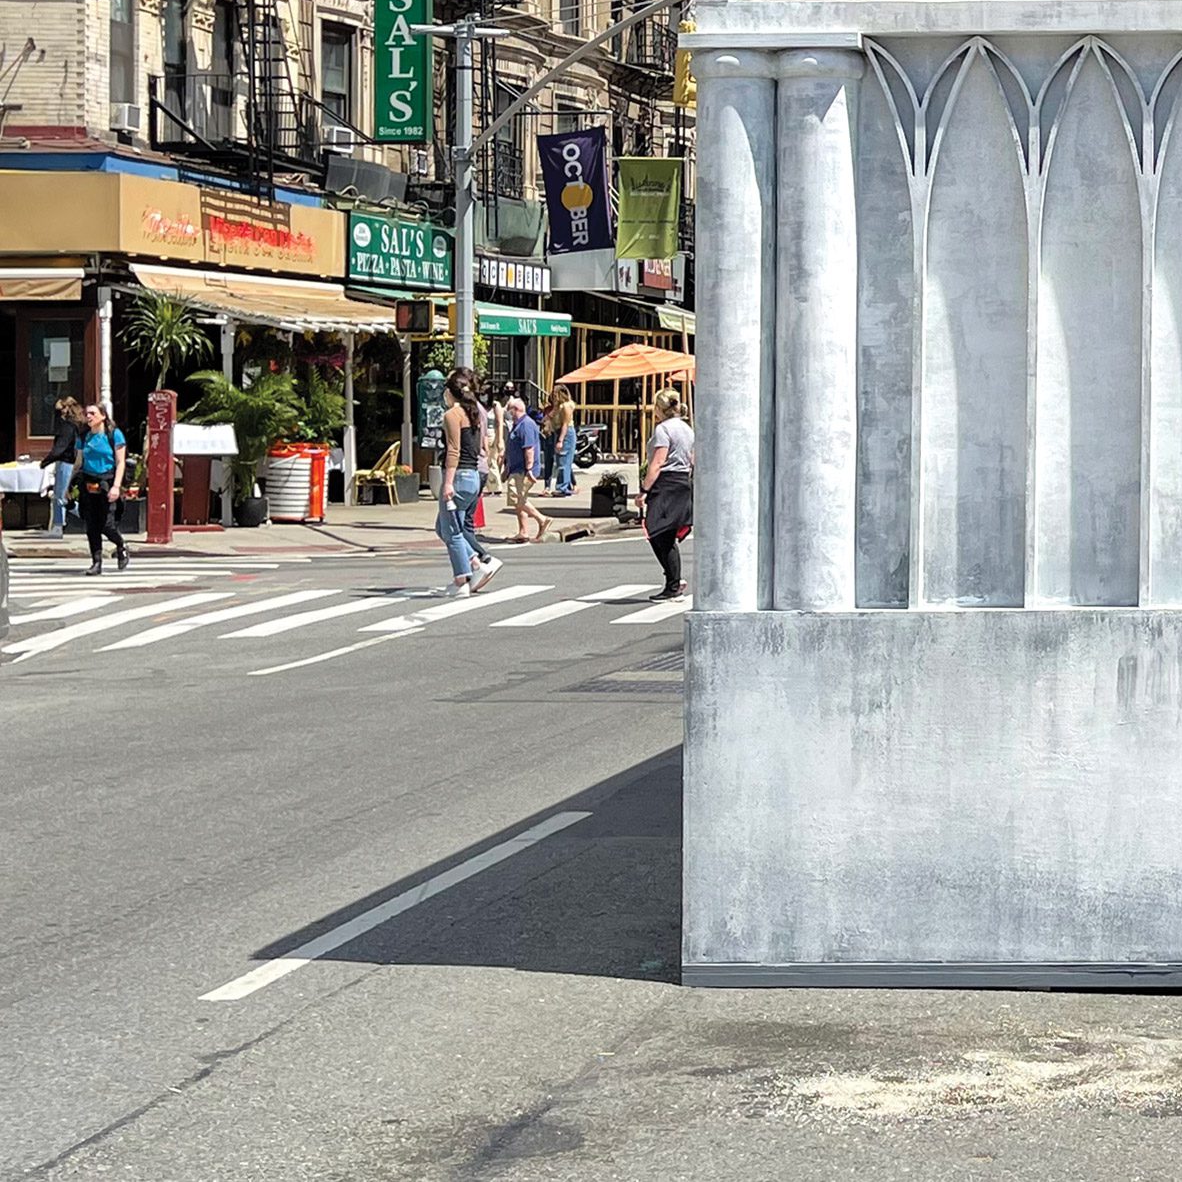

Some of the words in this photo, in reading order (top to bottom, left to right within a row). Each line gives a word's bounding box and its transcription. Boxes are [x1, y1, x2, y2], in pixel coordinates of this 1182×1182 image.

[378, 126, 401, 136] Since
[403, 126, 424, 136] 1982
[381, 224, 424, 258] SAL'S
[356, 252, 385, 275] PIZZA
[390, 256, 417, 279] PASTA
[422, 261, 445, 282] WINE
[518, 319, 538, 334] SAL'S
